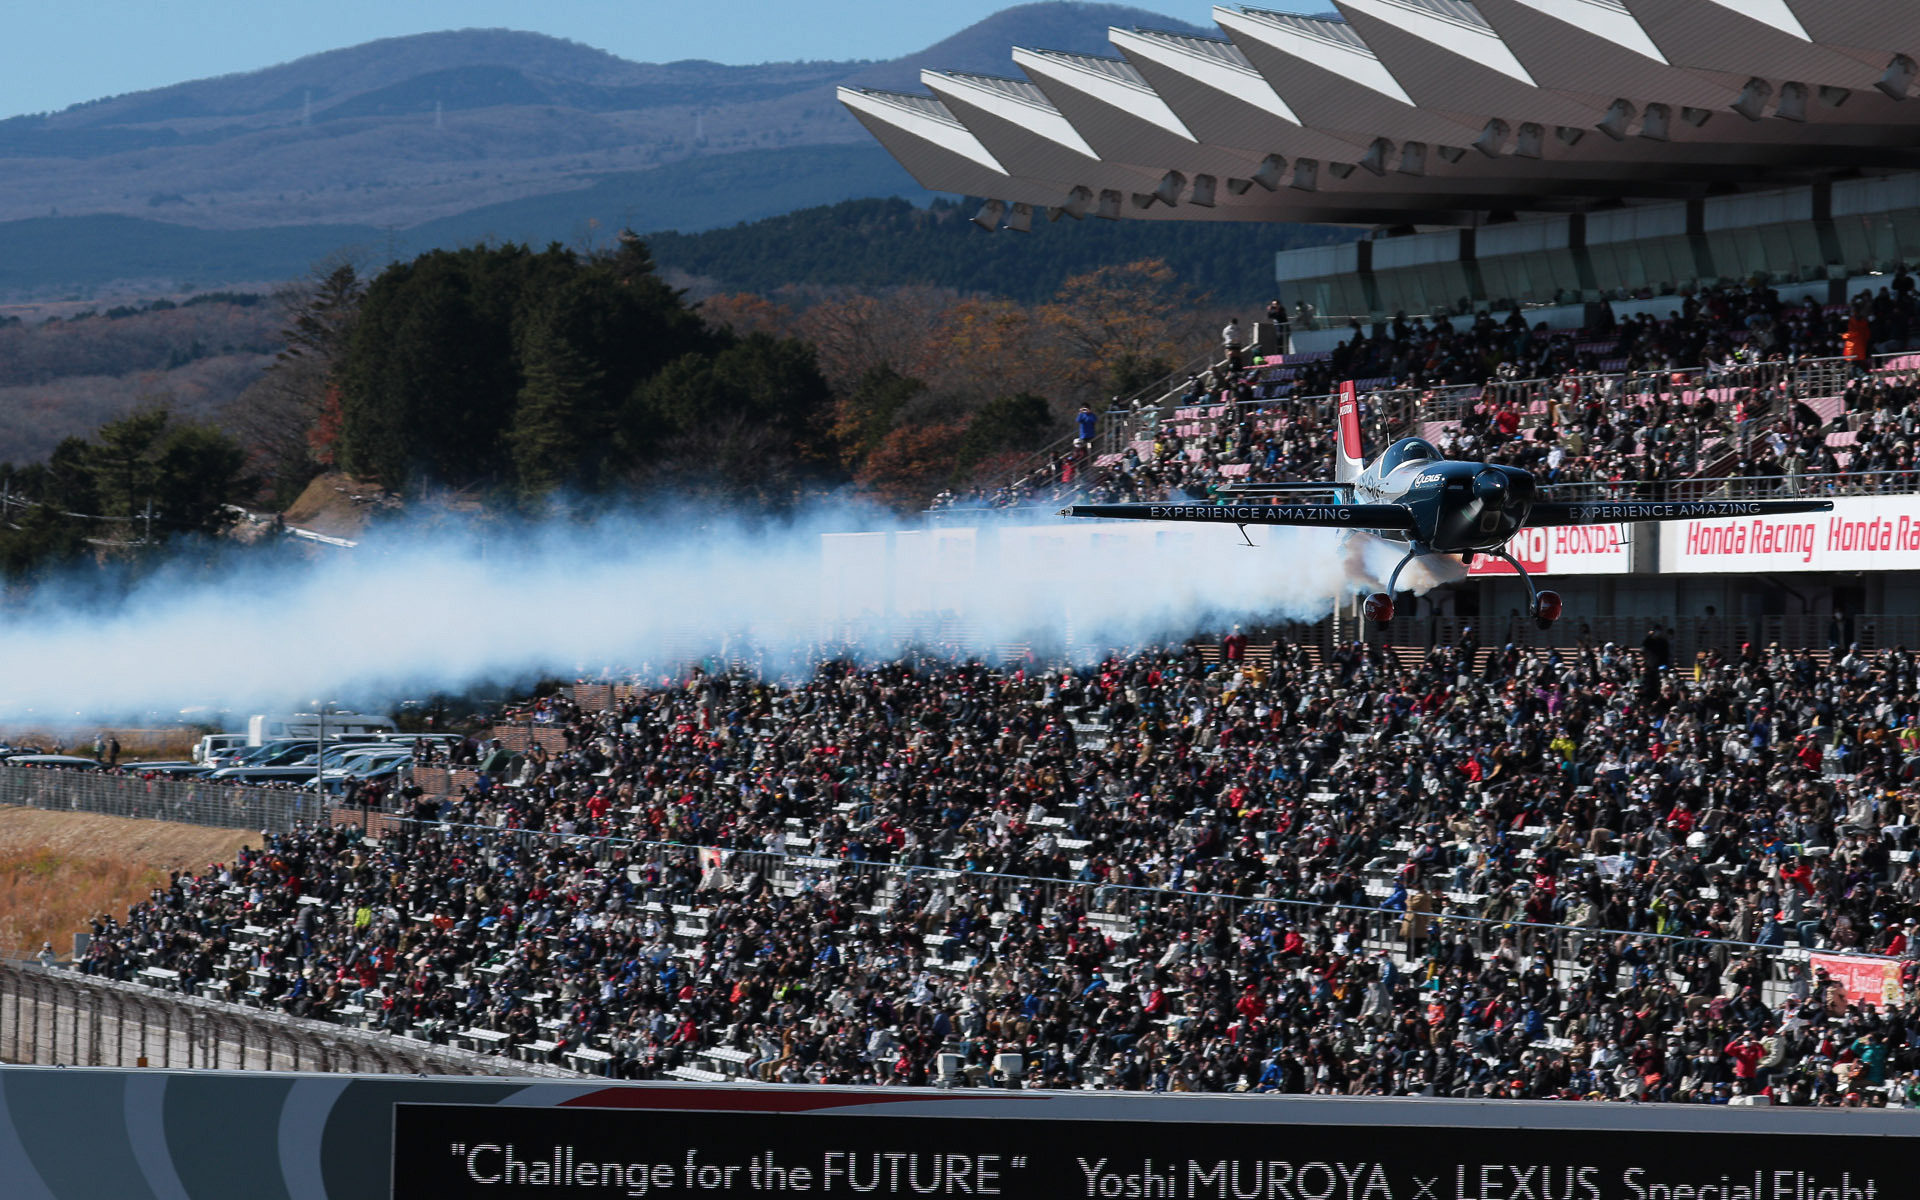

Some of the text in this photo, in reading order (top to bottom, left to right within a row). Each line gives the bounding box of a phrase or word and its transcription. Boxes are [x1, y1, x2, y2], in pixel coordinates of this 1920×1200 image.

[1150, 506, 1352, 521] EXPERIENCE AMAZING
[1569, 503, 1761, 519] EXPERIENCE AMAZING
[1555, 525, 1620, 554] HONDA
[1686, 519, 1816, 563] Honda Racing
[1827, 516, 1893, 551] Honda
[451, 1142, 675, 1197] "Challenge
[684, 1149, 742, 1189] for
[749, 1150, 813, 1191] the
[824, 1151, 1001, 1194] FUTURE
[1076, 1157, 1176, 1199] Yoshi
[1187, 1159, 1394, 1200] MUROYA
[1456, 1164, 1601, 1200] LEXUS
[1623, 1166, 1763, 1200] Special
[1773, 1170, 1879, 1200] Flight
